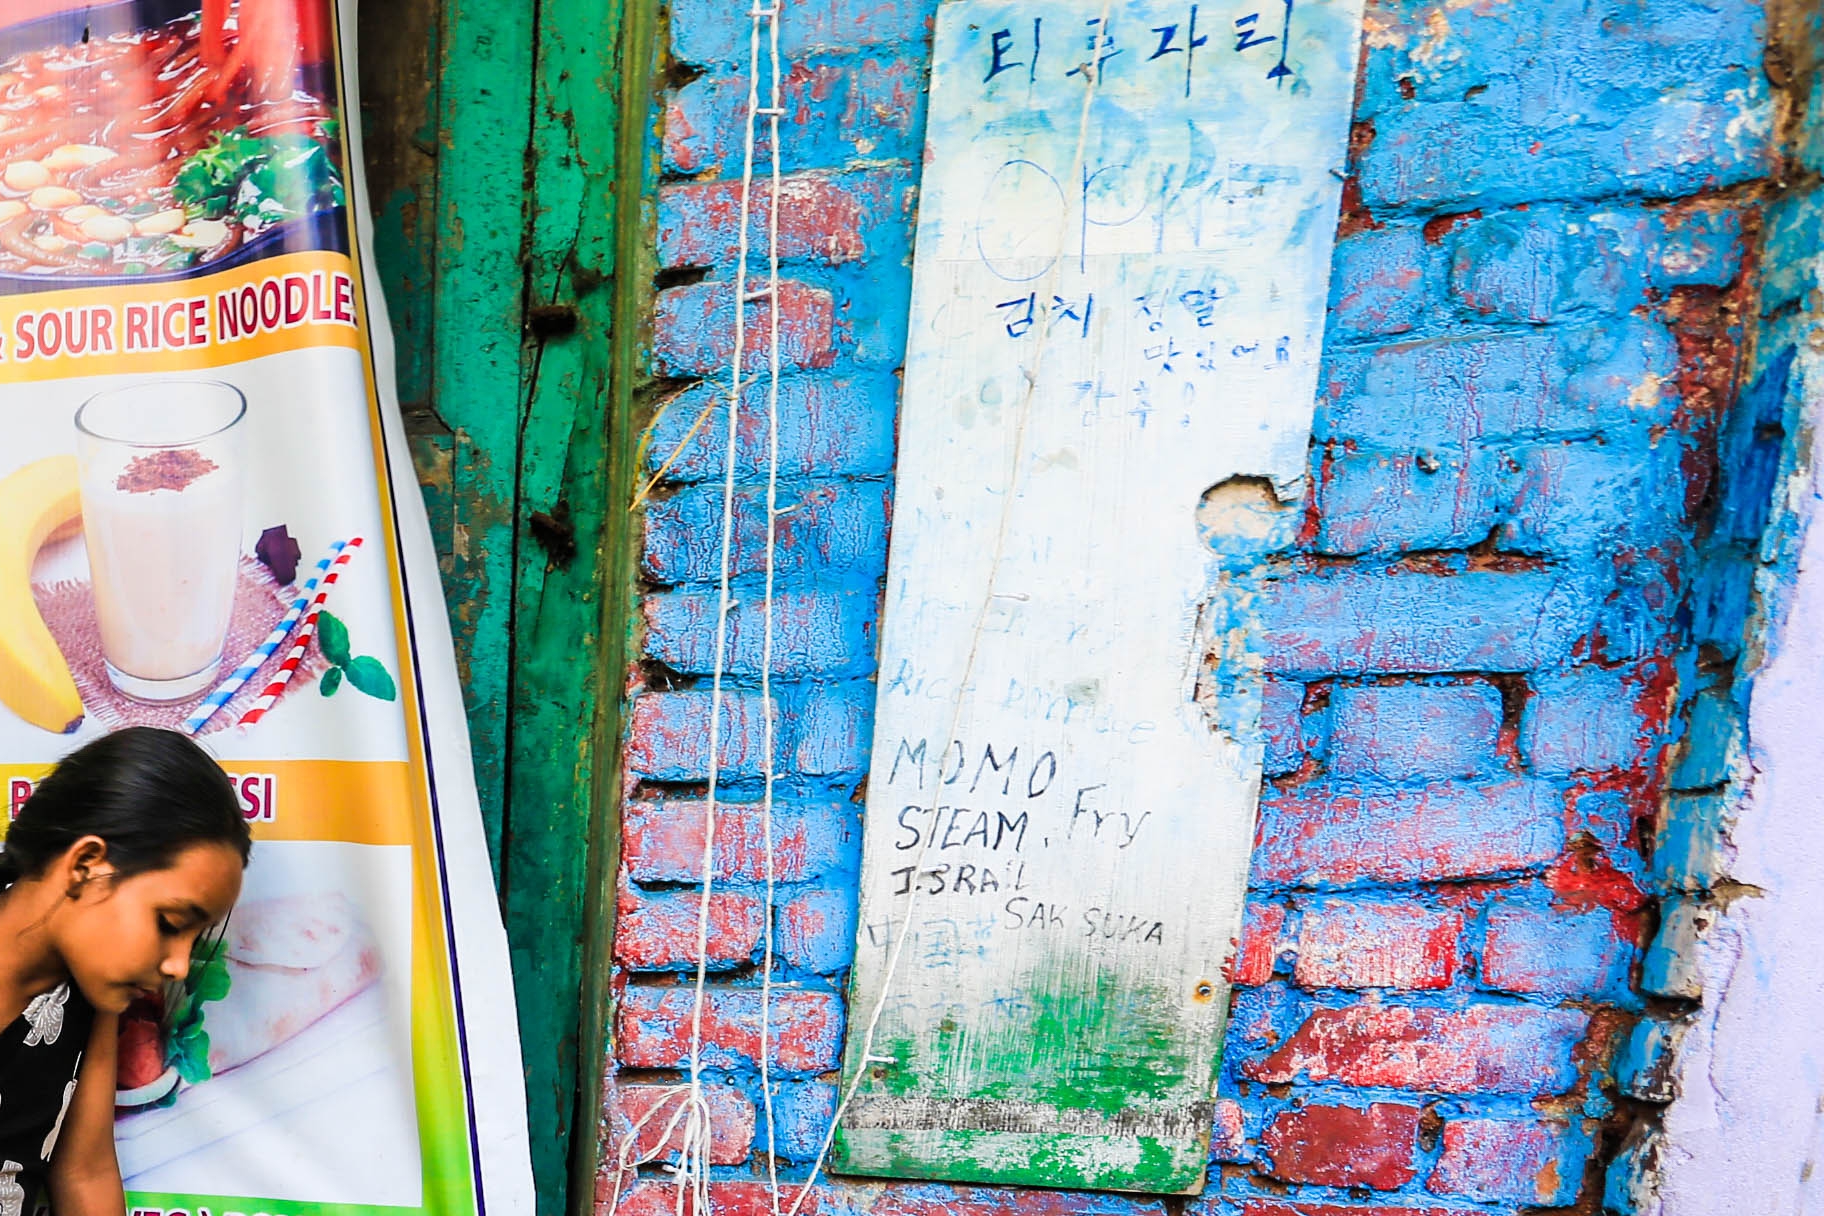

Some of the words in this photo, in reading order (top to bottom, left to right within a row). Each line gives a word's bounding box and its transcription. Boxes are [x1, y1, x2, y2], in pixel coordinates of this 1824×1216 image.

[16, 308, 112, 359] SOUR
[126, 300, 206, 349] RICE
[996, 291, 1093, 338] 김치
[888, 736, 1057, 798] MOMO
[1005, 897, 1067, 930] SAK
